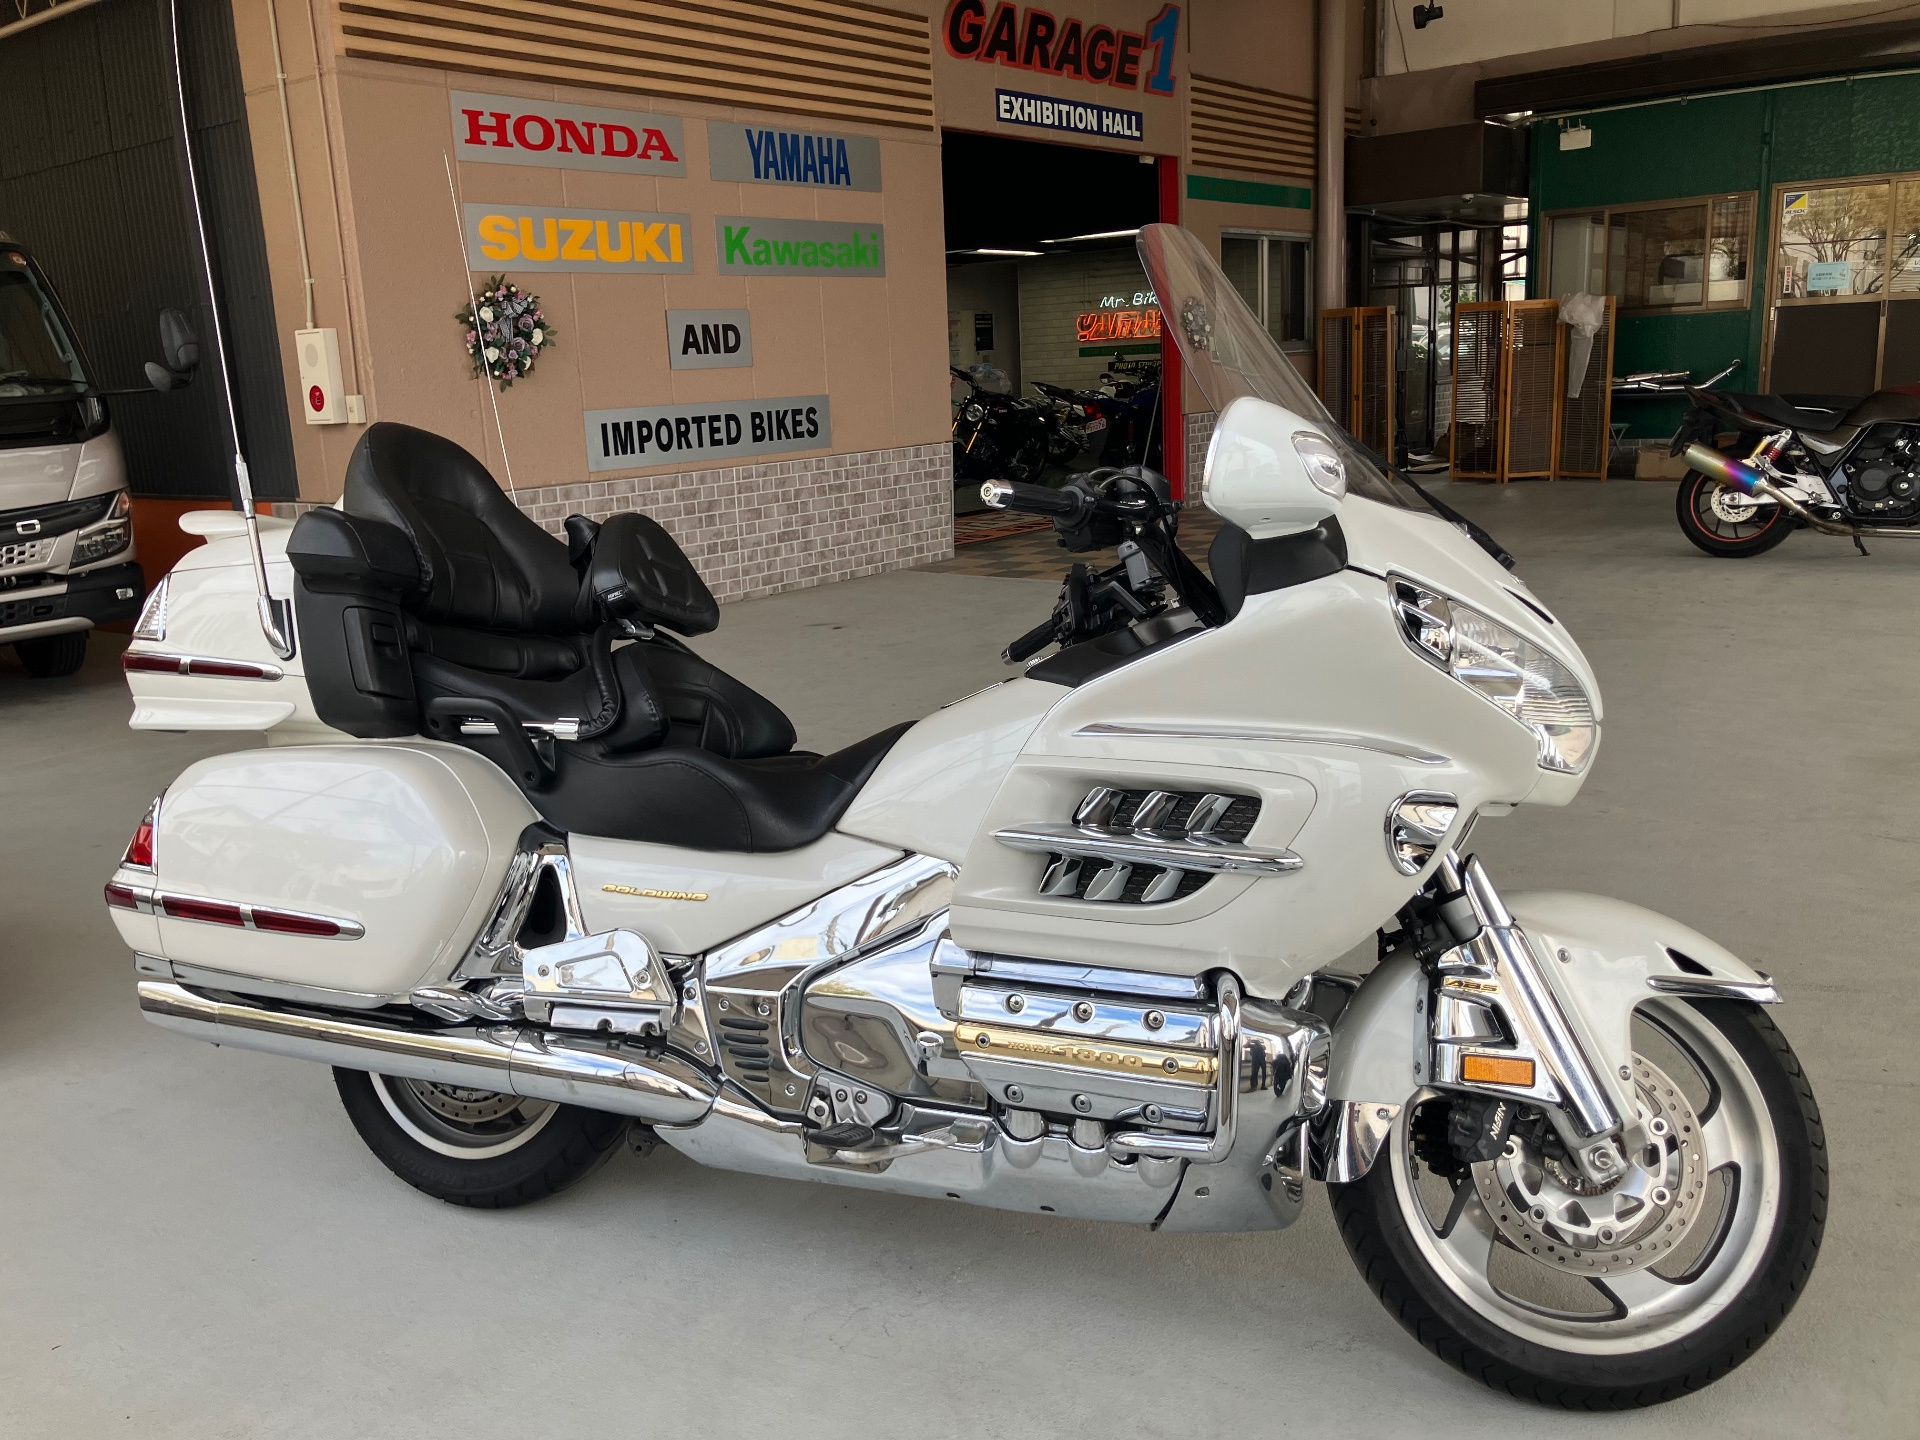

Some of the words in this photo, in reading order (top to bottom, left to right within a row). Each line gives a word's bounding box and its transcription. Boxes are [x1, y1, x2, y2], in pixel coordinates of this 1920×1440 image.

[942, 0, 1144, 90] GARAGE
[1144, 3, 1181, 97] 1
[462, 109, 679, 162] HONDA
[998, 94, 1098, 131] EXHIBITION
[1102, 111, 1141, 137] HALL
[745, 129, 852, 186] YAMAHA
[479, 215, 683, 263] SUZUKI
[724, 226, 879, 268] Kawasaki
[682, 324, 741, 355] AND
[601, 415, 742, 457] IMPORTED
[750, 407, 819, 442] BIKES
[602, 884, 708, 901] GOLDWING
[1445, 979, 1498, 992] ABS
[1007, 1041, 1055, 1055] HONDA
[1060, 1046, 1143, 1068] 1800
